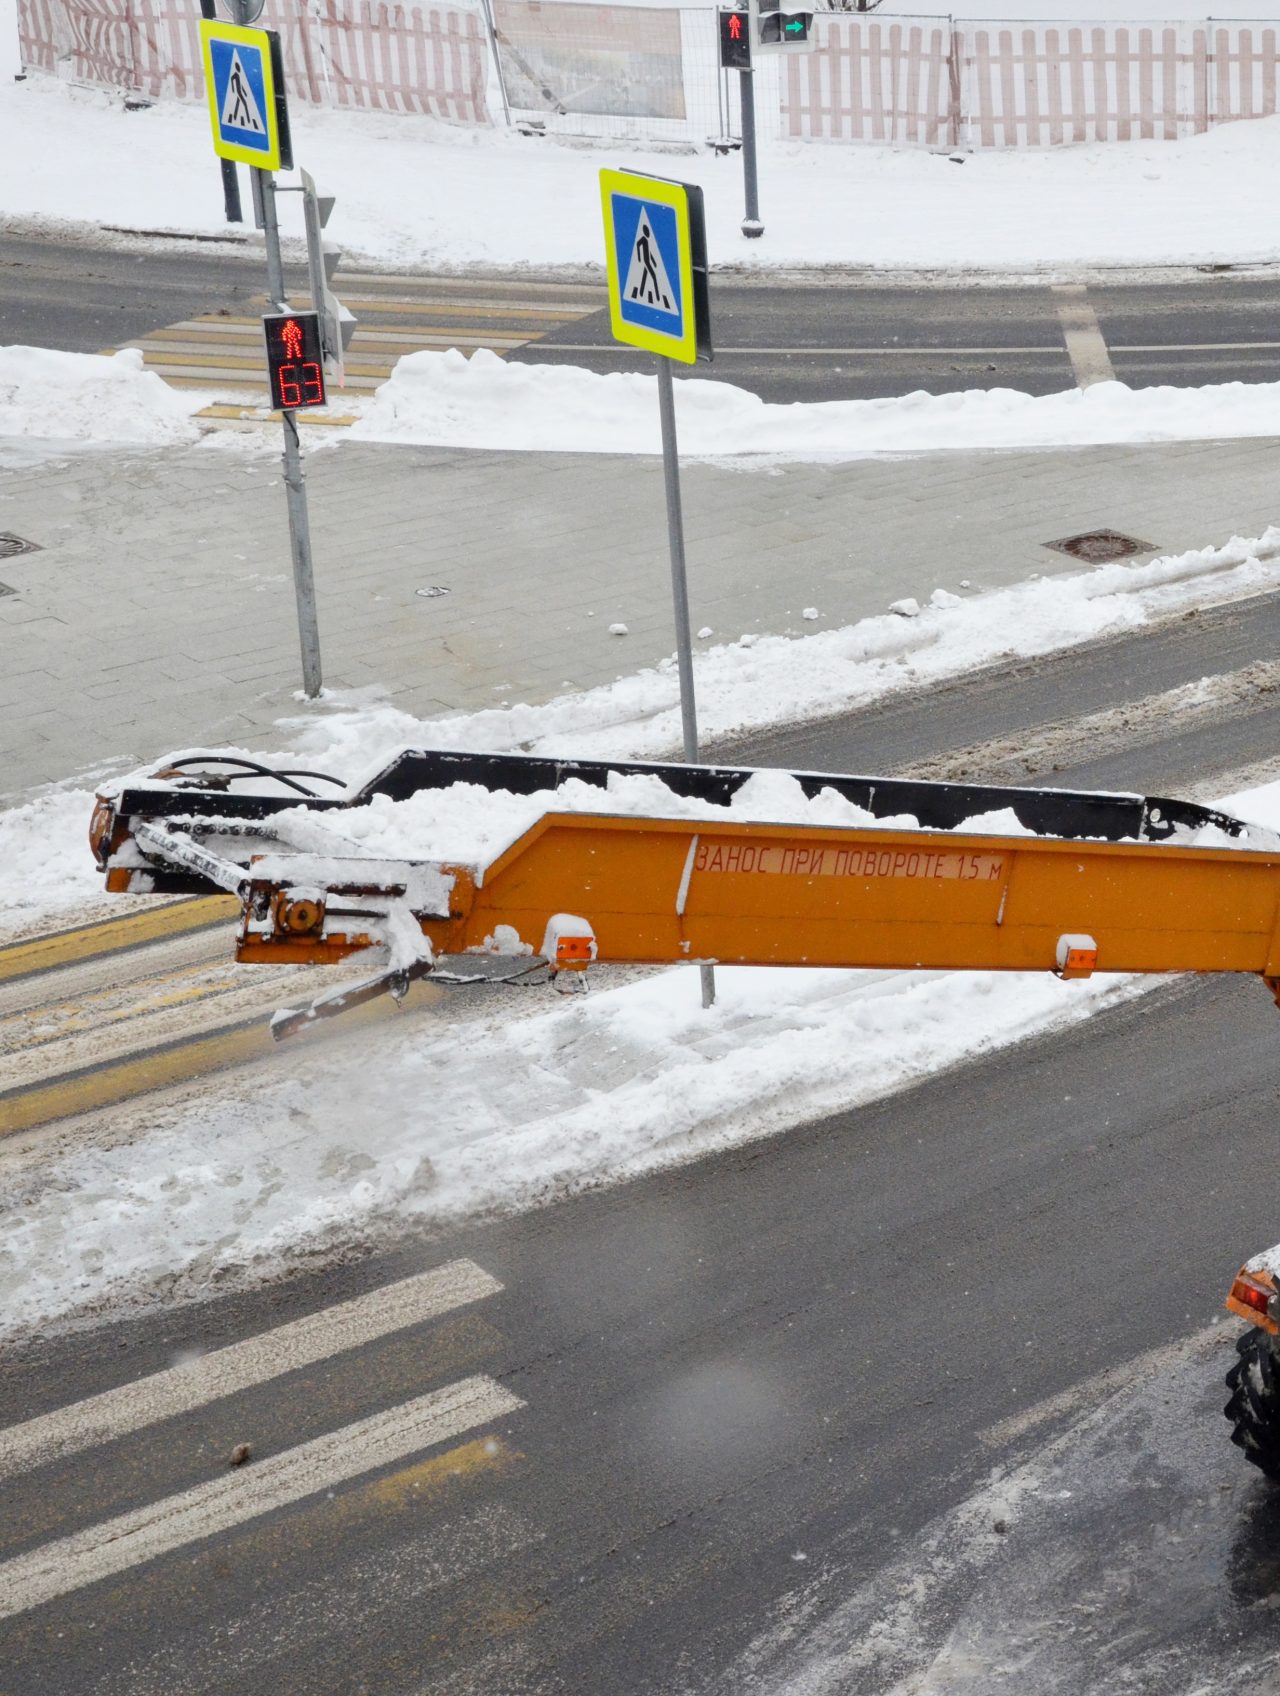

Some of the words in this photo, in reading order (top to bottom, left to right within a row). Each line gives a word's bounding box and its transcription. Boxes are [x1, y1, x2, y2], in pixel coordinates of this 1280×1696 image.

[279, 362, 322, 406] 63
[696, 846, 771, 873] ЗАНОС
[781, 849, 825, 875] ПРИ
[833, 851, 946, 879] ПОВОРОТЕ
